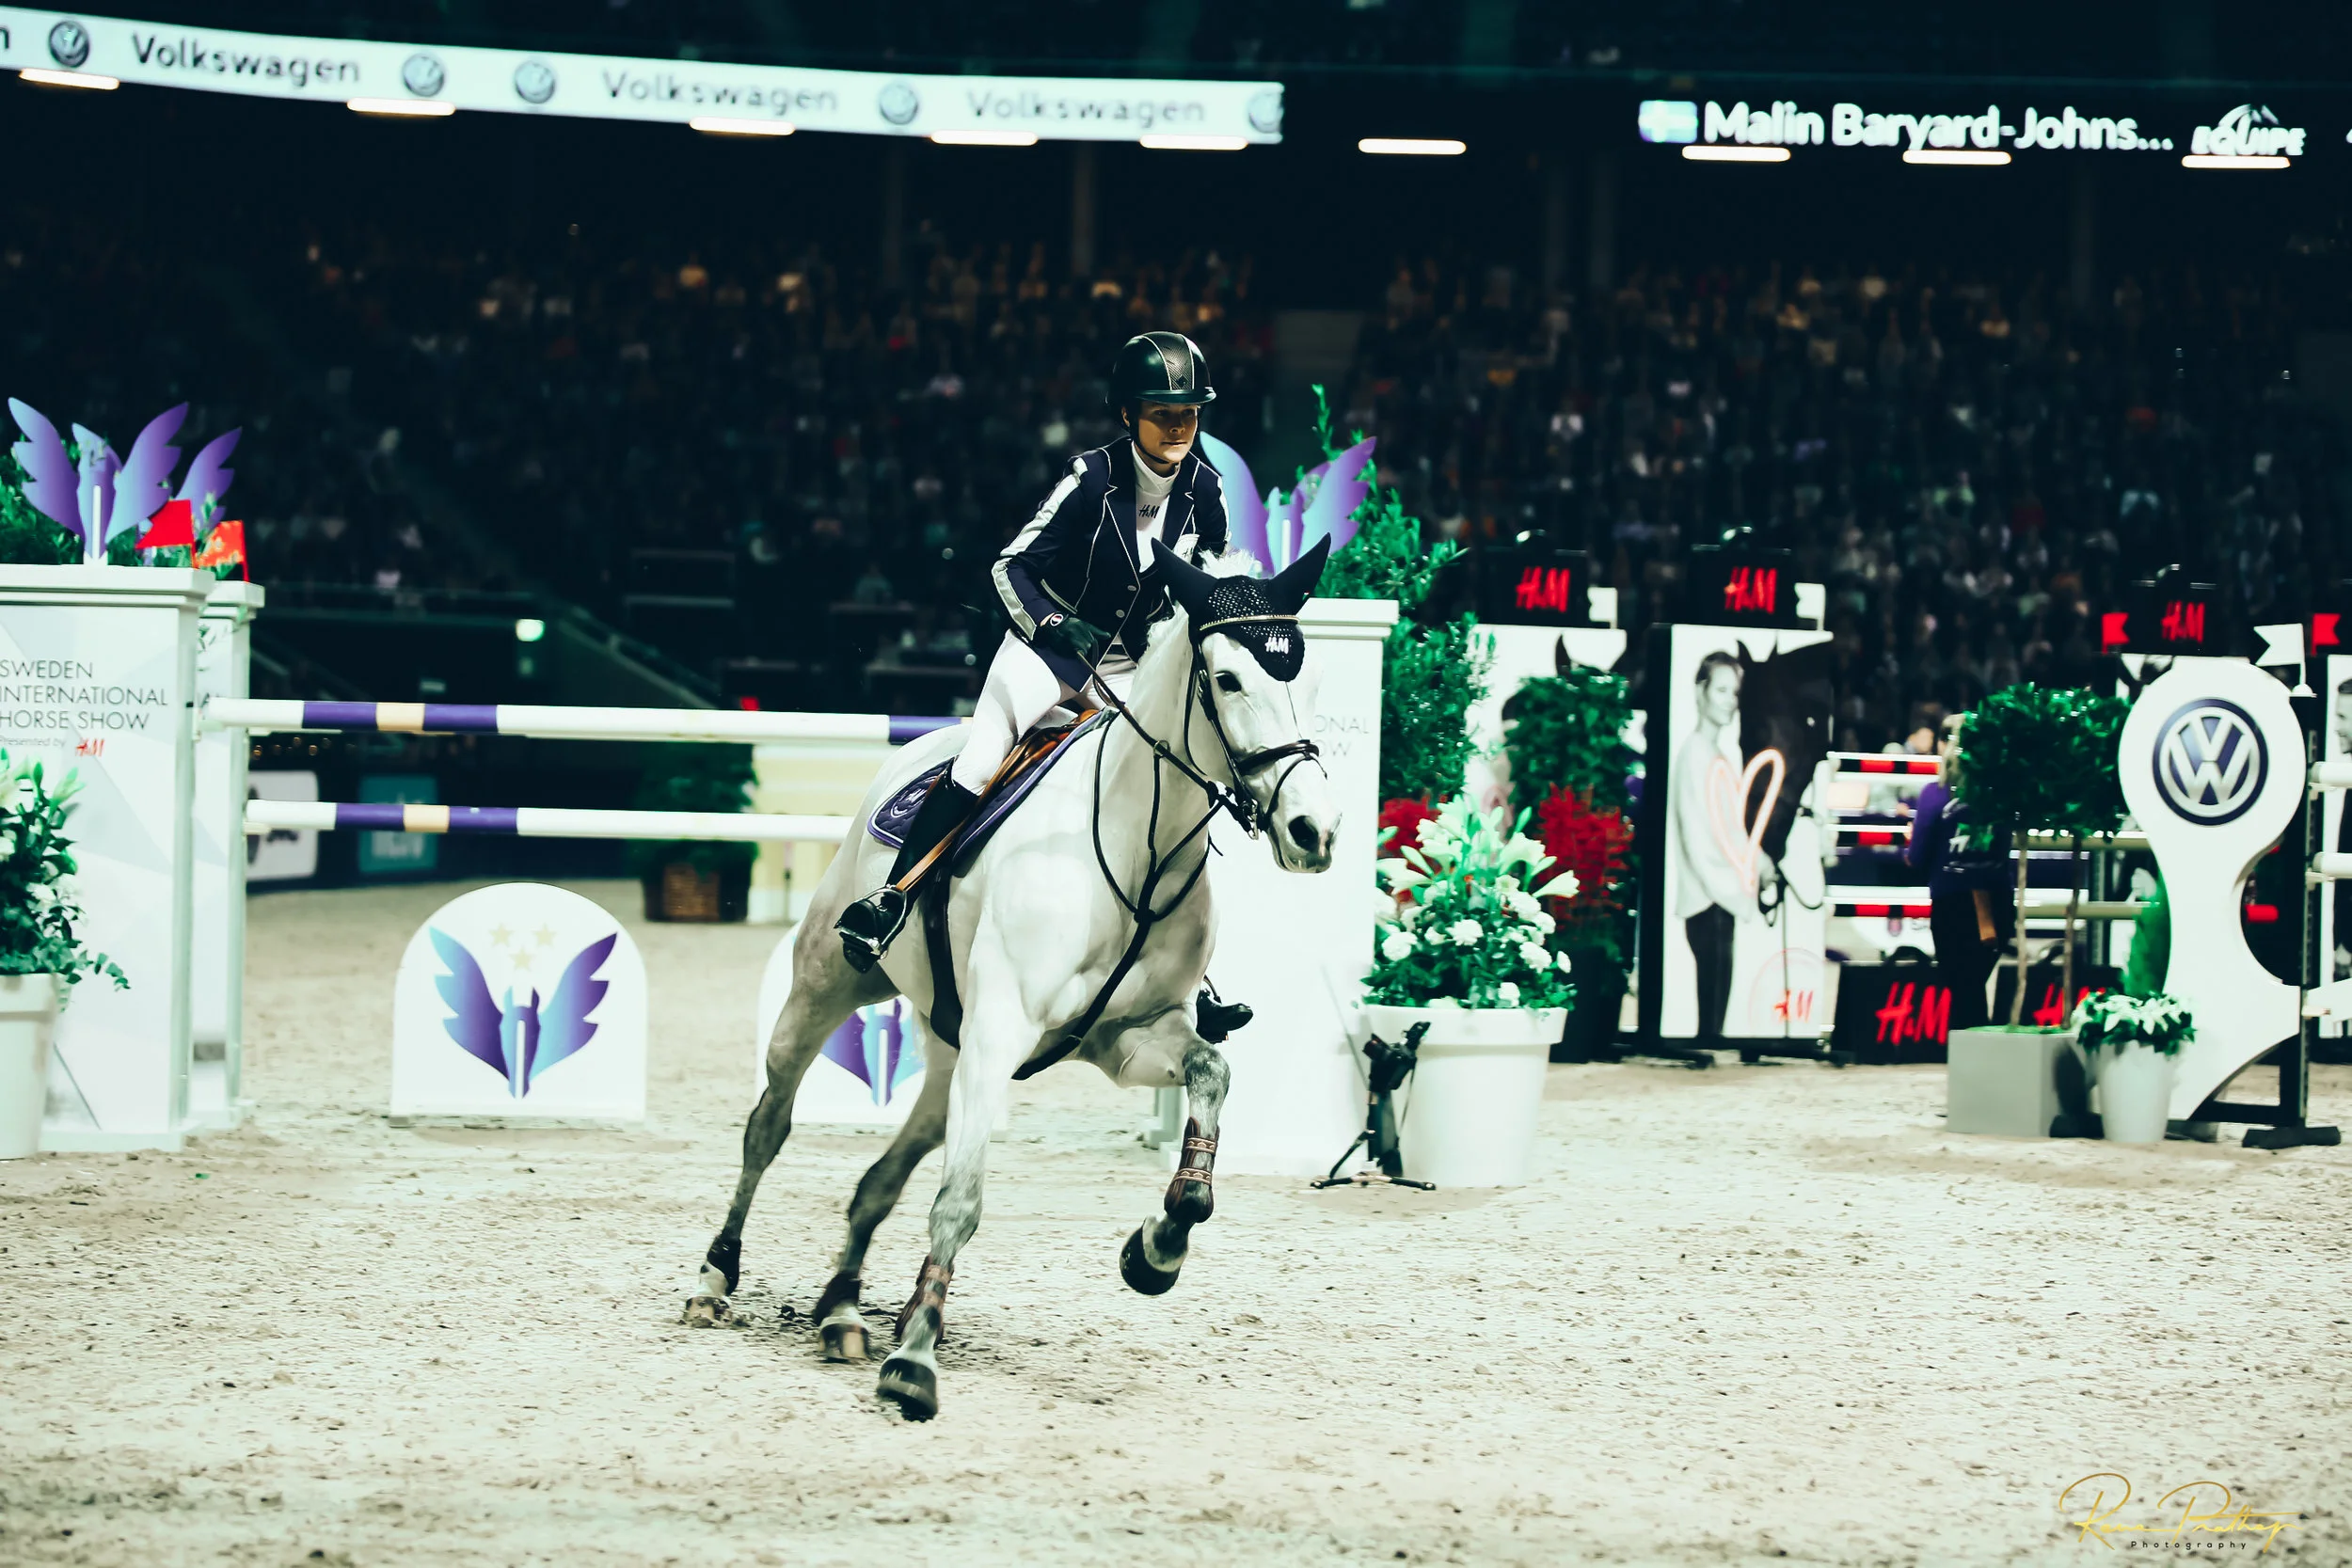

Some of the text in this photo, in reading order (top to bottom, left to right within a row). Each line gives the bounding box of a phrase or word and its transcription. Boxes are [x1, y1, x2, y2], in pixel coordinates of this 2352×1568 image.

[132, 31, 360, 88] Volkswagen
[602, 70, 837, 117] Volkswagen
[966, 88, 1205, 129] Volkswagen
[1704, 101, 2173, 151] Malin Baryard-Johns...
[0, 659, 93, 679] SWEDEN
[0, 684, 168, 706] INTERNATIONAL
[0, 708, 151, 731] HORSE SHOW
[1876, 981, 1952, 1047] H&M
